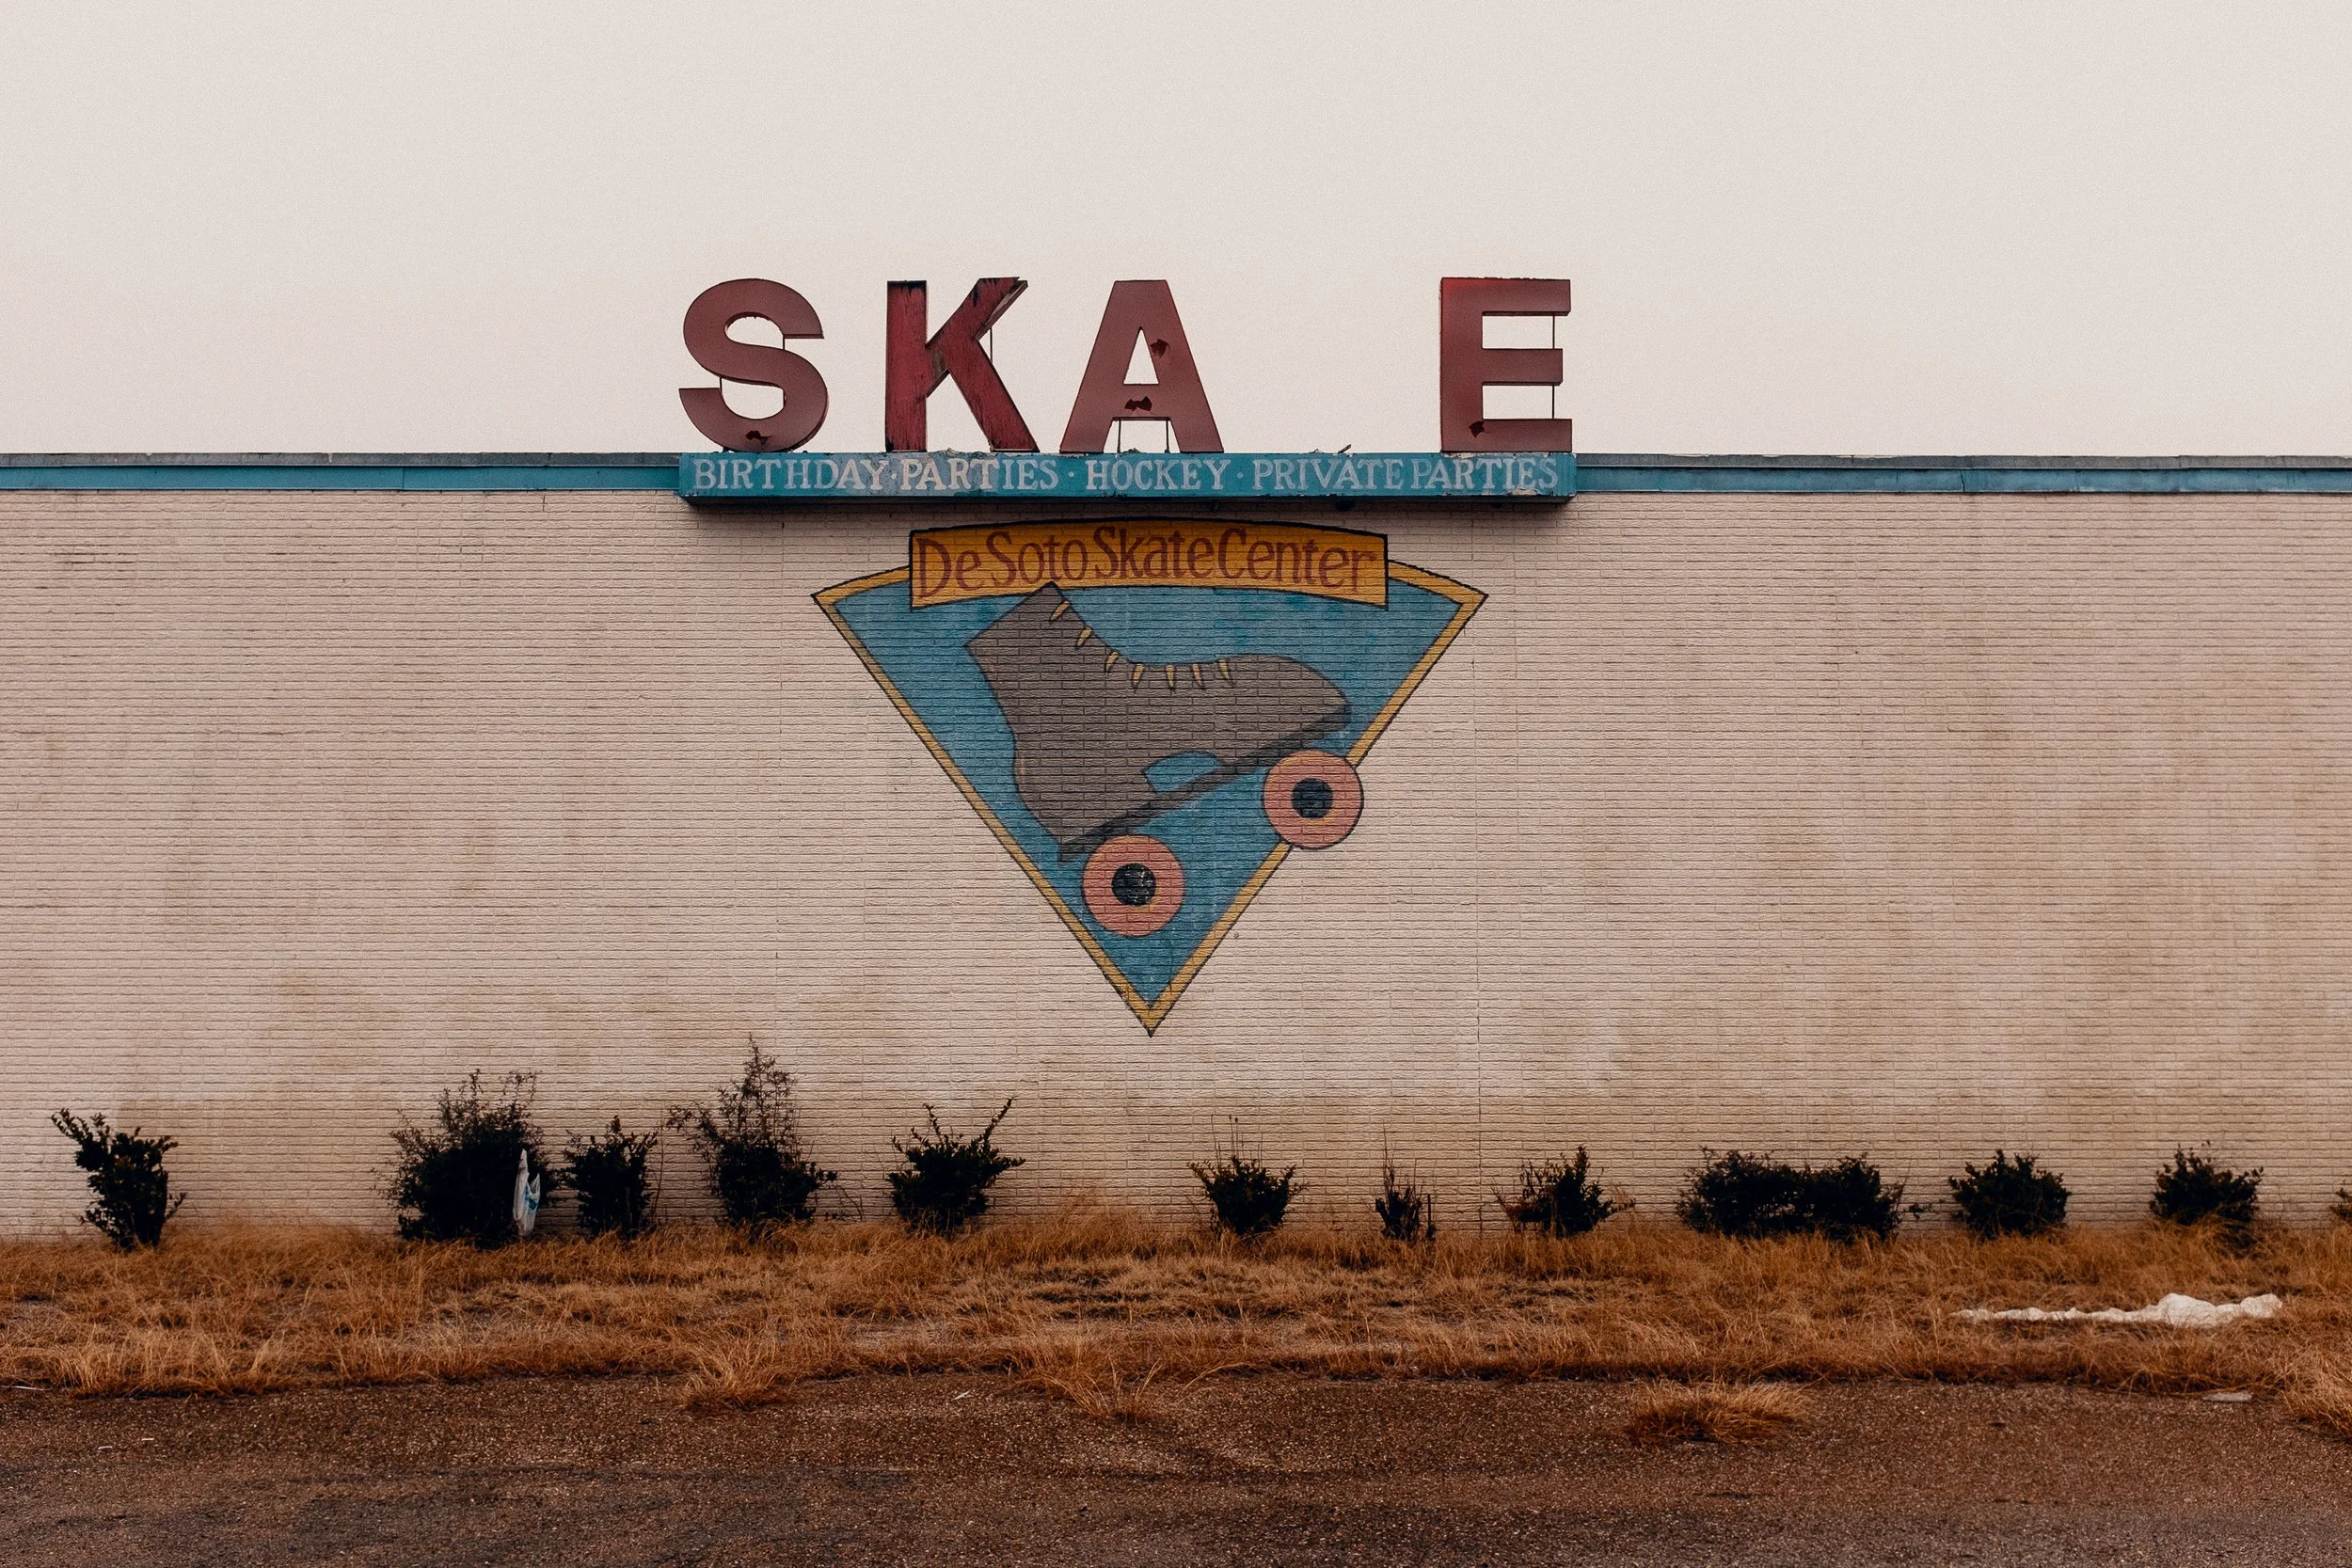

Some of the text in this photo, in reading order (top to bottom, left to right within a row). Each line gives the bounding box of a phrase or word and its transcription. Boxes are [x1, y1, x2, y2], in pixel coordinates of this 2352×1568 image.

[693, 458, 1559, 491] BIRTHDAY PARTIES HOCKEY PRIVATE PARTIES
[1092, 526, 1216, 581] Skate
[1218, 528, 1377, 594] Center
